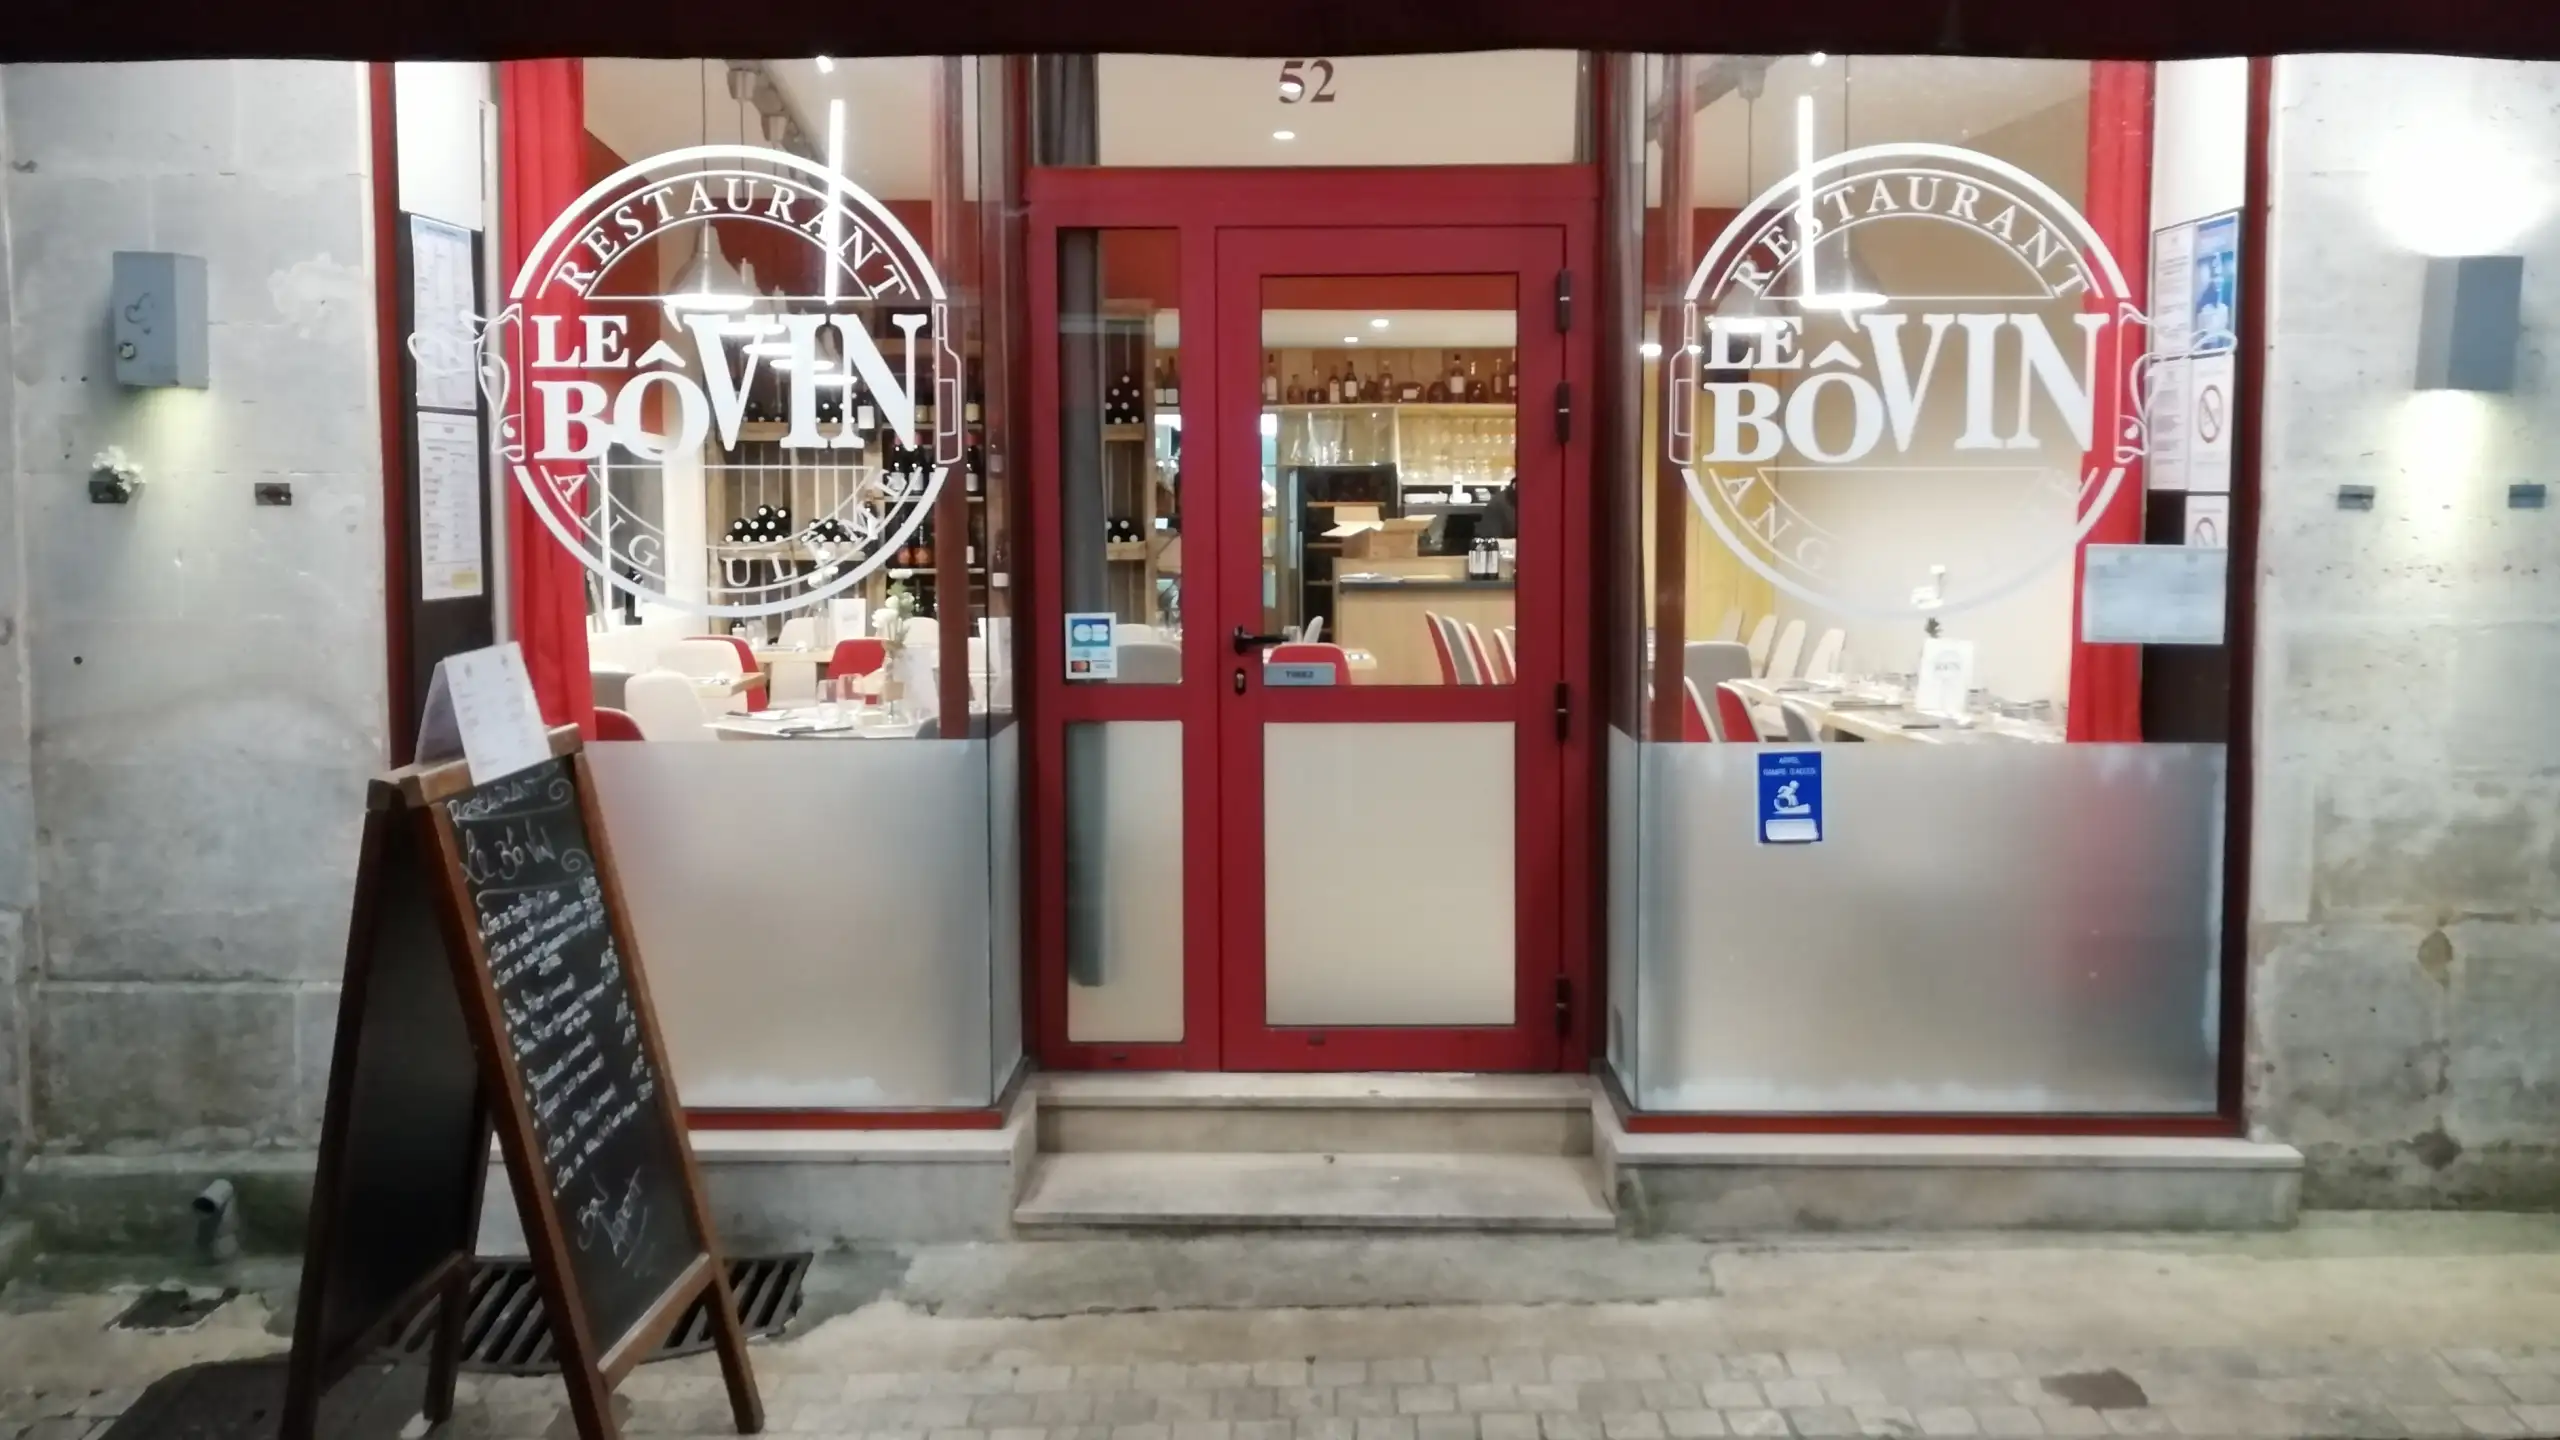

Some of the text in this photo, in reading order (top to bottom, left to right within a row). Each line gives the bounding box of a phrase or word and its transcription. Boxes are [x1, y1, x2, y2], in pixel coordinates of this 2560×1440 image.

[1278, 59, 1337, 104] 52
[555, 178, 907, 299] RESTAURANT
[1730, 176, 2091, 297] RESTAURANT
[531, 314, 630, 368] LE
[1703, 315, 1804, 370] LE
